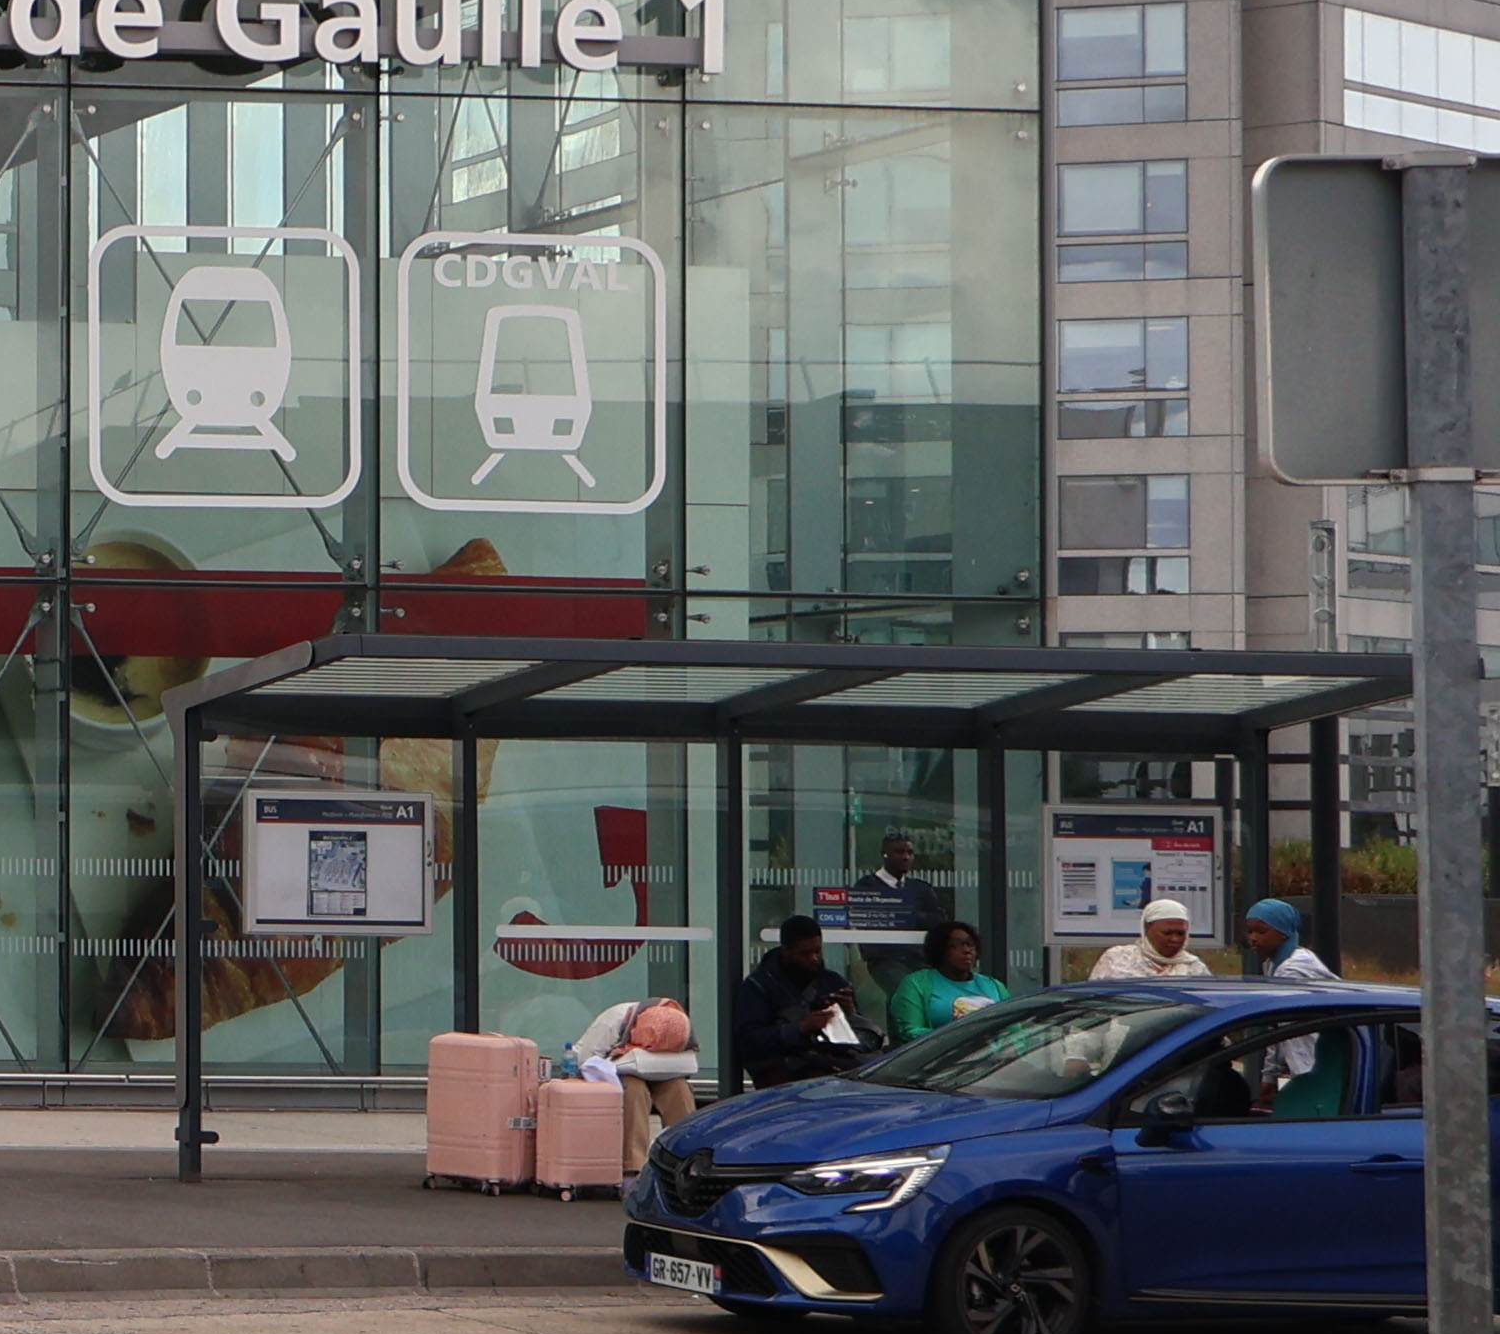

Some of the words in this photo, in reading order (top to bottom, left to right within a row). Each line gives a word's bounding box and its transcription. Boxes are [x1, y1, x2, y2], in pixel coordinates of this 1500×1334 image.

[433, 253, 630, 291] CDGVAL
[396, 805, 414, 819] A1
[1186, 820, 1204, 833] A1
